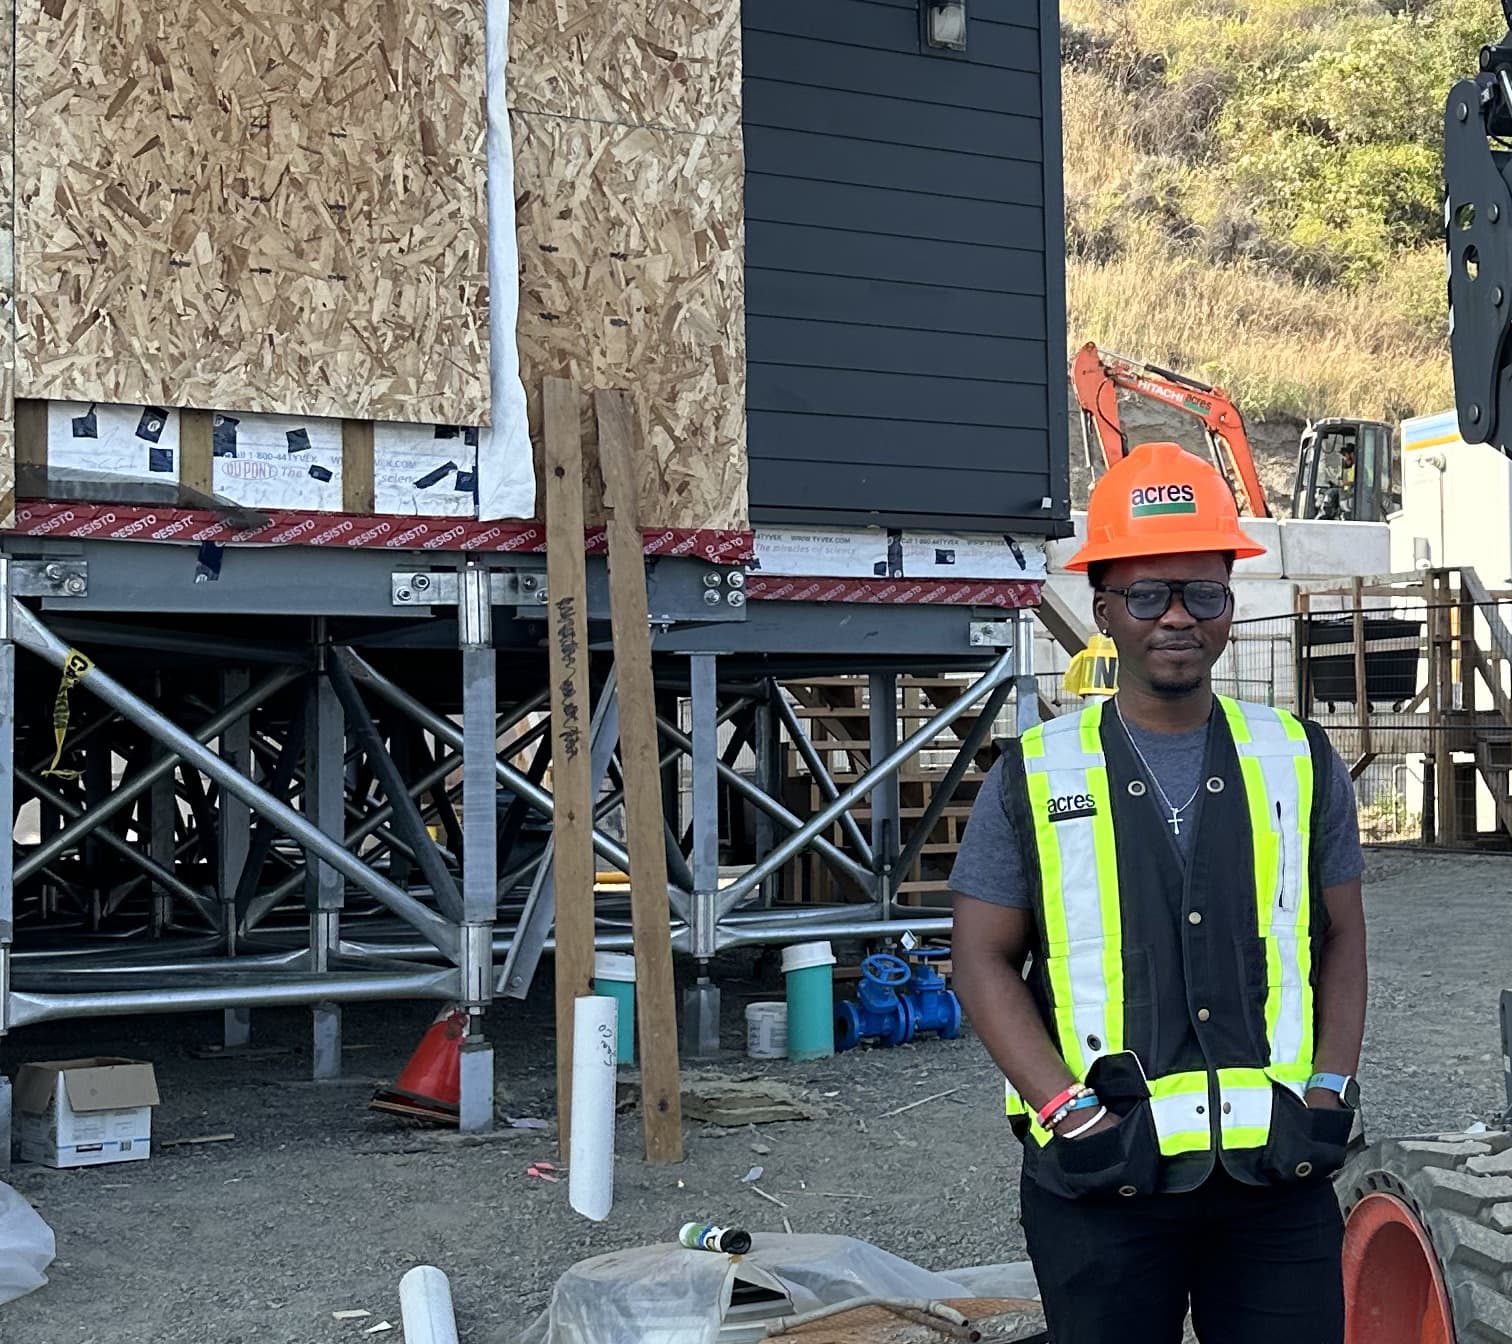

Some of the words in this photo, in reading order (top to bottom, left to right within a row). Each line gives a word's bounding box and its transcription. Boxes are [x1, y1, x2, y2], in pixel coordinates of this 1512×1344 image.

[1137, 380, 1185, 402] HITACHI
[1185, 394, 1212, 410] acres
[1131, 484, 1194, 505] acres
[1046, 791, 1096, 815] acres
